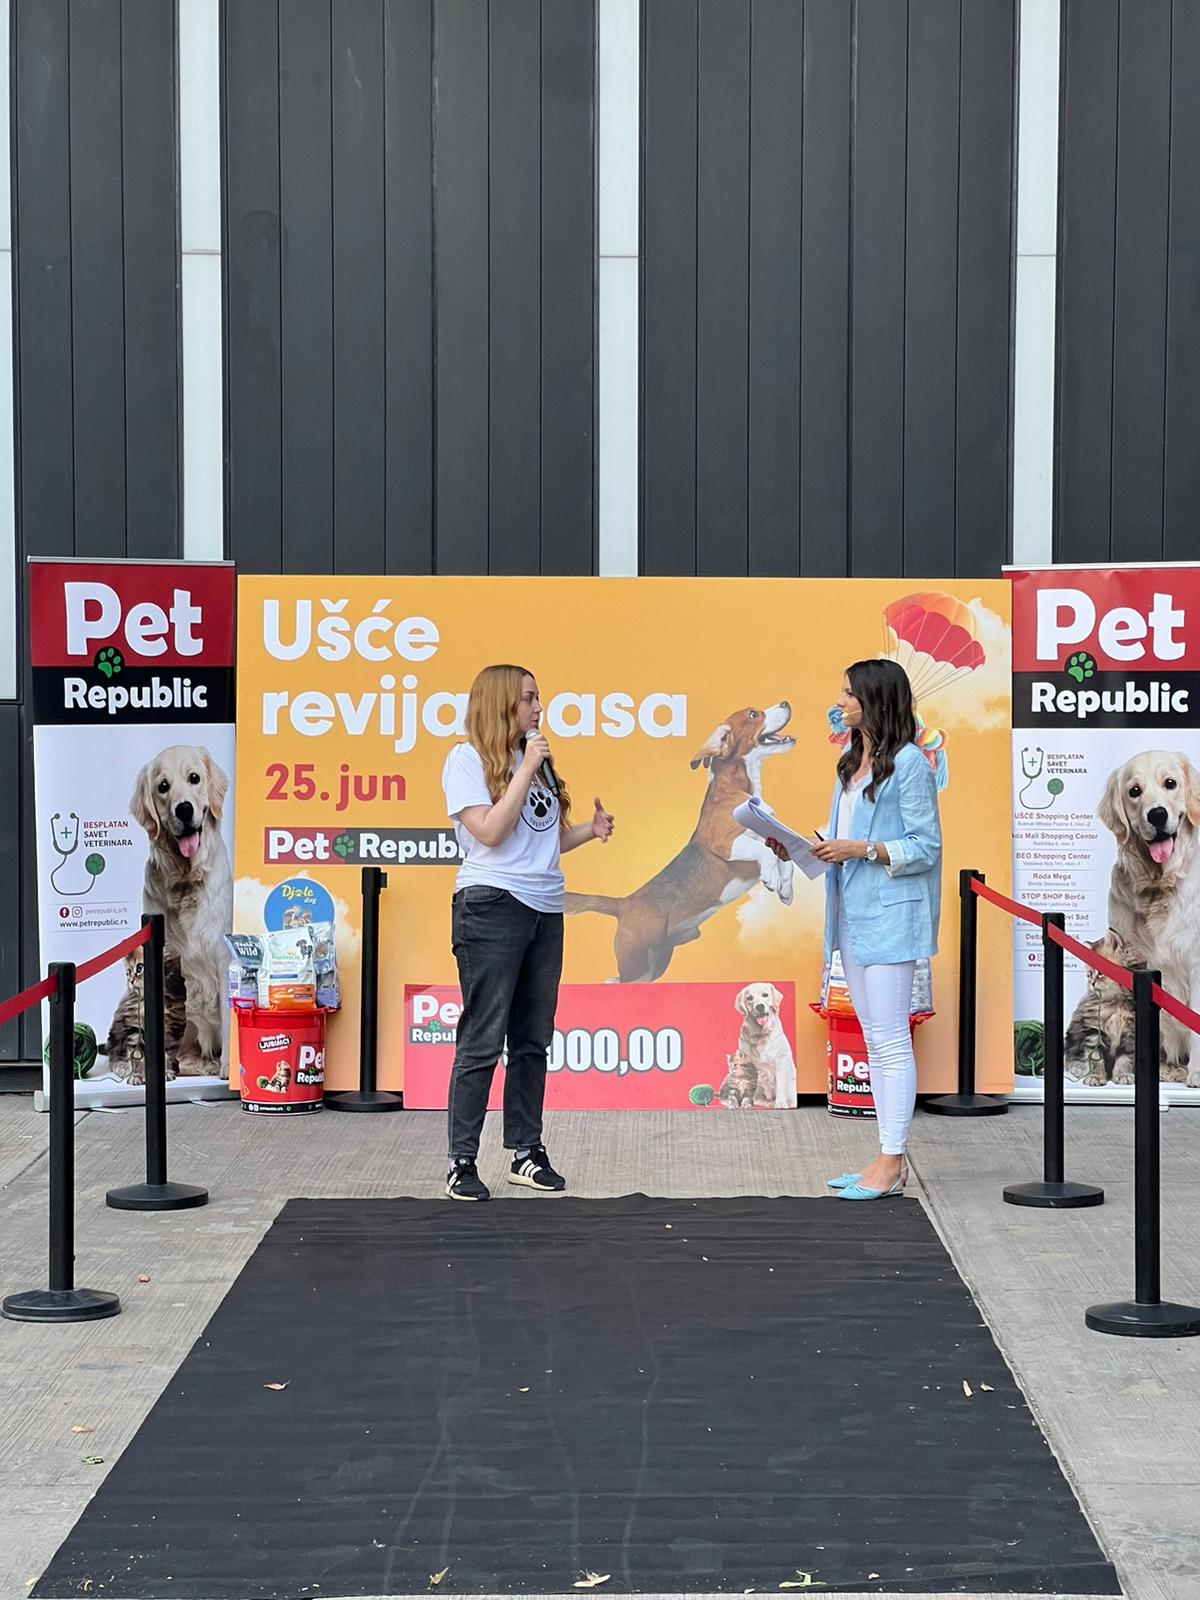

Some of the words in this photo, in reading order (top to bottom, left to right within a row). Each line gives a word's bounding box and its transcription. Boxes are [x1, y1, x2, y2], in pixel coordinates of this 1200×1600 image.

[64, 582, 204, 657] Pet
[263, 598, 441, 662] Ušće
[1036, 588, 1187, 662] Pet
[63, 677, 208, 715] Republic
[1031, 681, 1190, 719] Republic
[262, 674, 471, 755] revija
[538, 691, 688, 739] asa
[265, 763, 330, 802] 25.
[335, 763, 407, 812] jun
[83, 820, 129, 829] BESPLATAN
[1035, 812, 1069, 821] Shopping
[1070, 812, 1094, 820] Center
[83, 830, 109, 838] SAVET
[83, 839, 134, 848] VETERINARA
[268, 830, 330, 861] Pet
[1040, 832, 1074, 841] Shopping
[1033, 853, 1067, 861] Shopping
[1053, 873, 1072, 881] Mega
[60, 918, 129, 928] www.petrepublic.rs
[413, 995, 464, 1024] Pe
